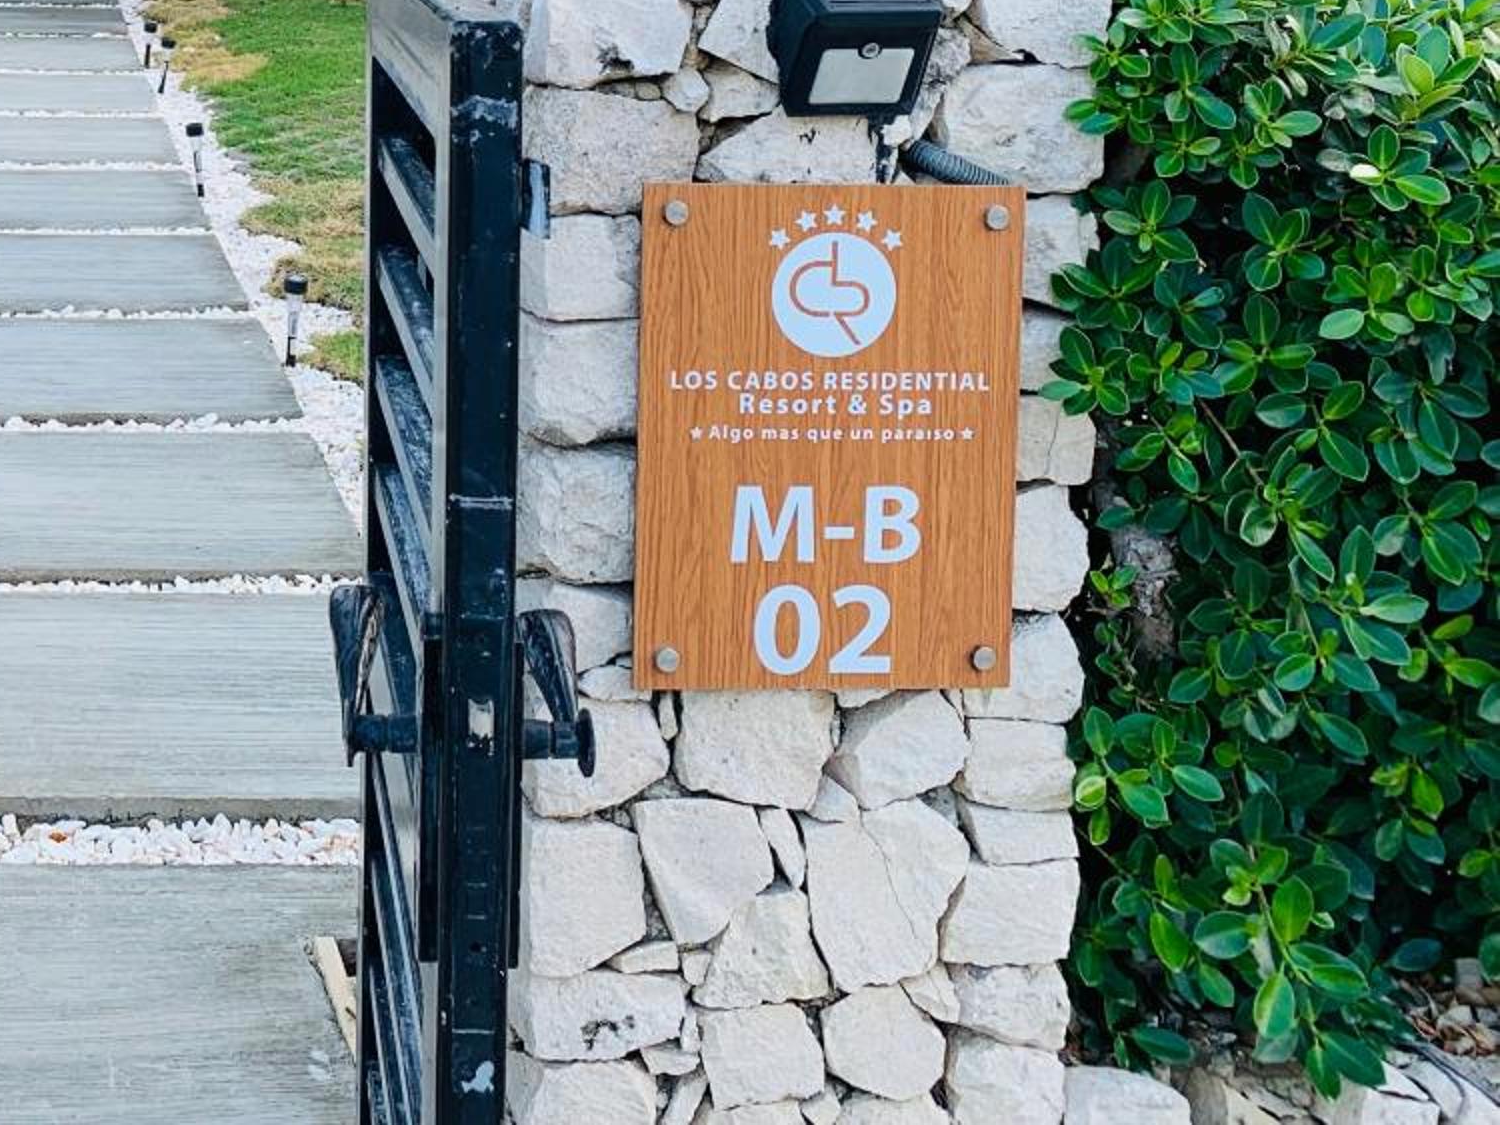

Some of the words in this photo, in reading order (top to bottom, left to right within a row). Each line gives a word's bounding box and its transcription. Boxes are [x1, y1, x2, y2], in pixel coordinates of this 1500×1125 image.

[670, 370, 718, 391] LOS
[727, 370, 814, 392] CABOS
[823, 371, 990, 392] RESIDENTIAL
[739, 393, 837, 415] Resort
[847, 394, 867, 415] &
[879, 393, 932, 420] Spa
[708, 425, 754, 443] Algo
[761, 428, 799, 441] mas
[806, 428, 843, 444] que
[850, 428, 874, 441] un
[729, 484, 922, 564] M-B
[753, 583, 892, 676] 02
